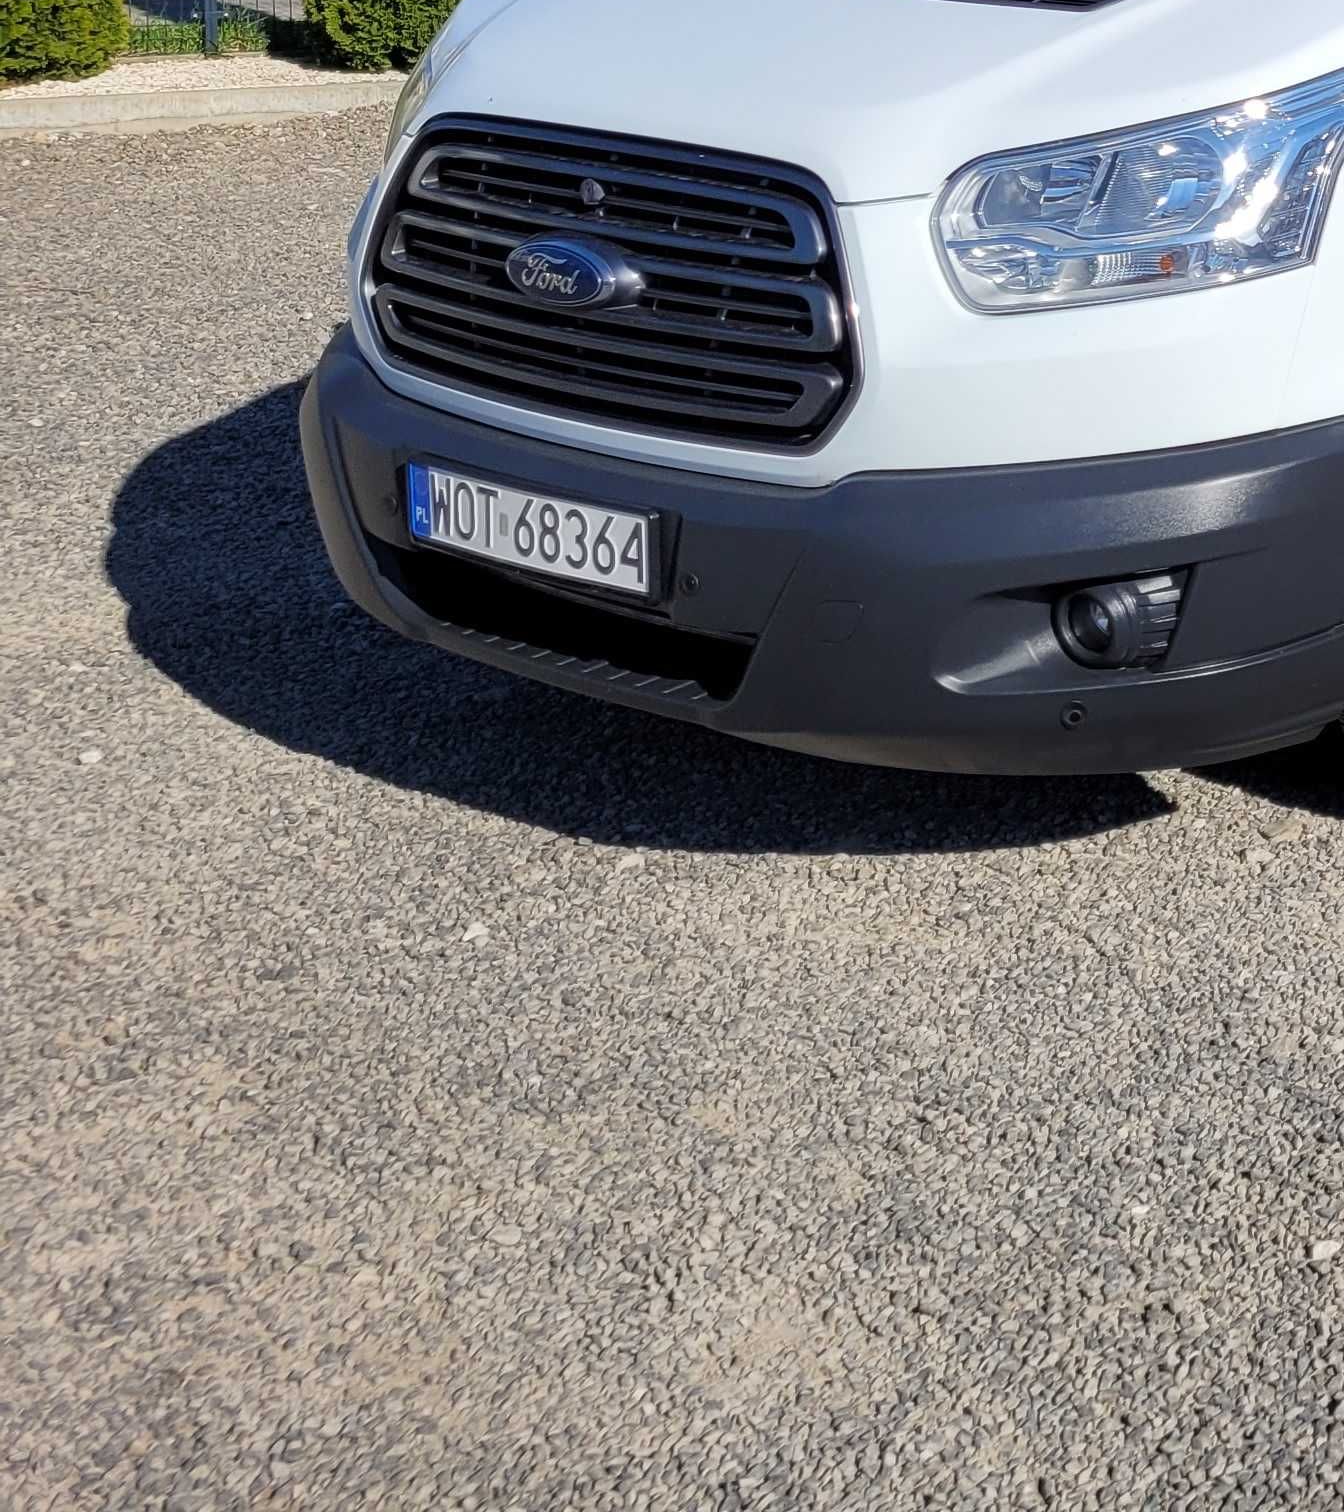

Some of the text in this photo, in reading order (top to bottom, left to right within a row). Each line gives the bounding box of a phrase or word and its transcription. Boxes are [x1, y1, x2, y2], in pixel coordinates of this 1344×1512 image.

[521, 252, 581, 295] Ford
[415, 505, 429, 525] PL
[431, 473, 644, 584] WOT 68364
